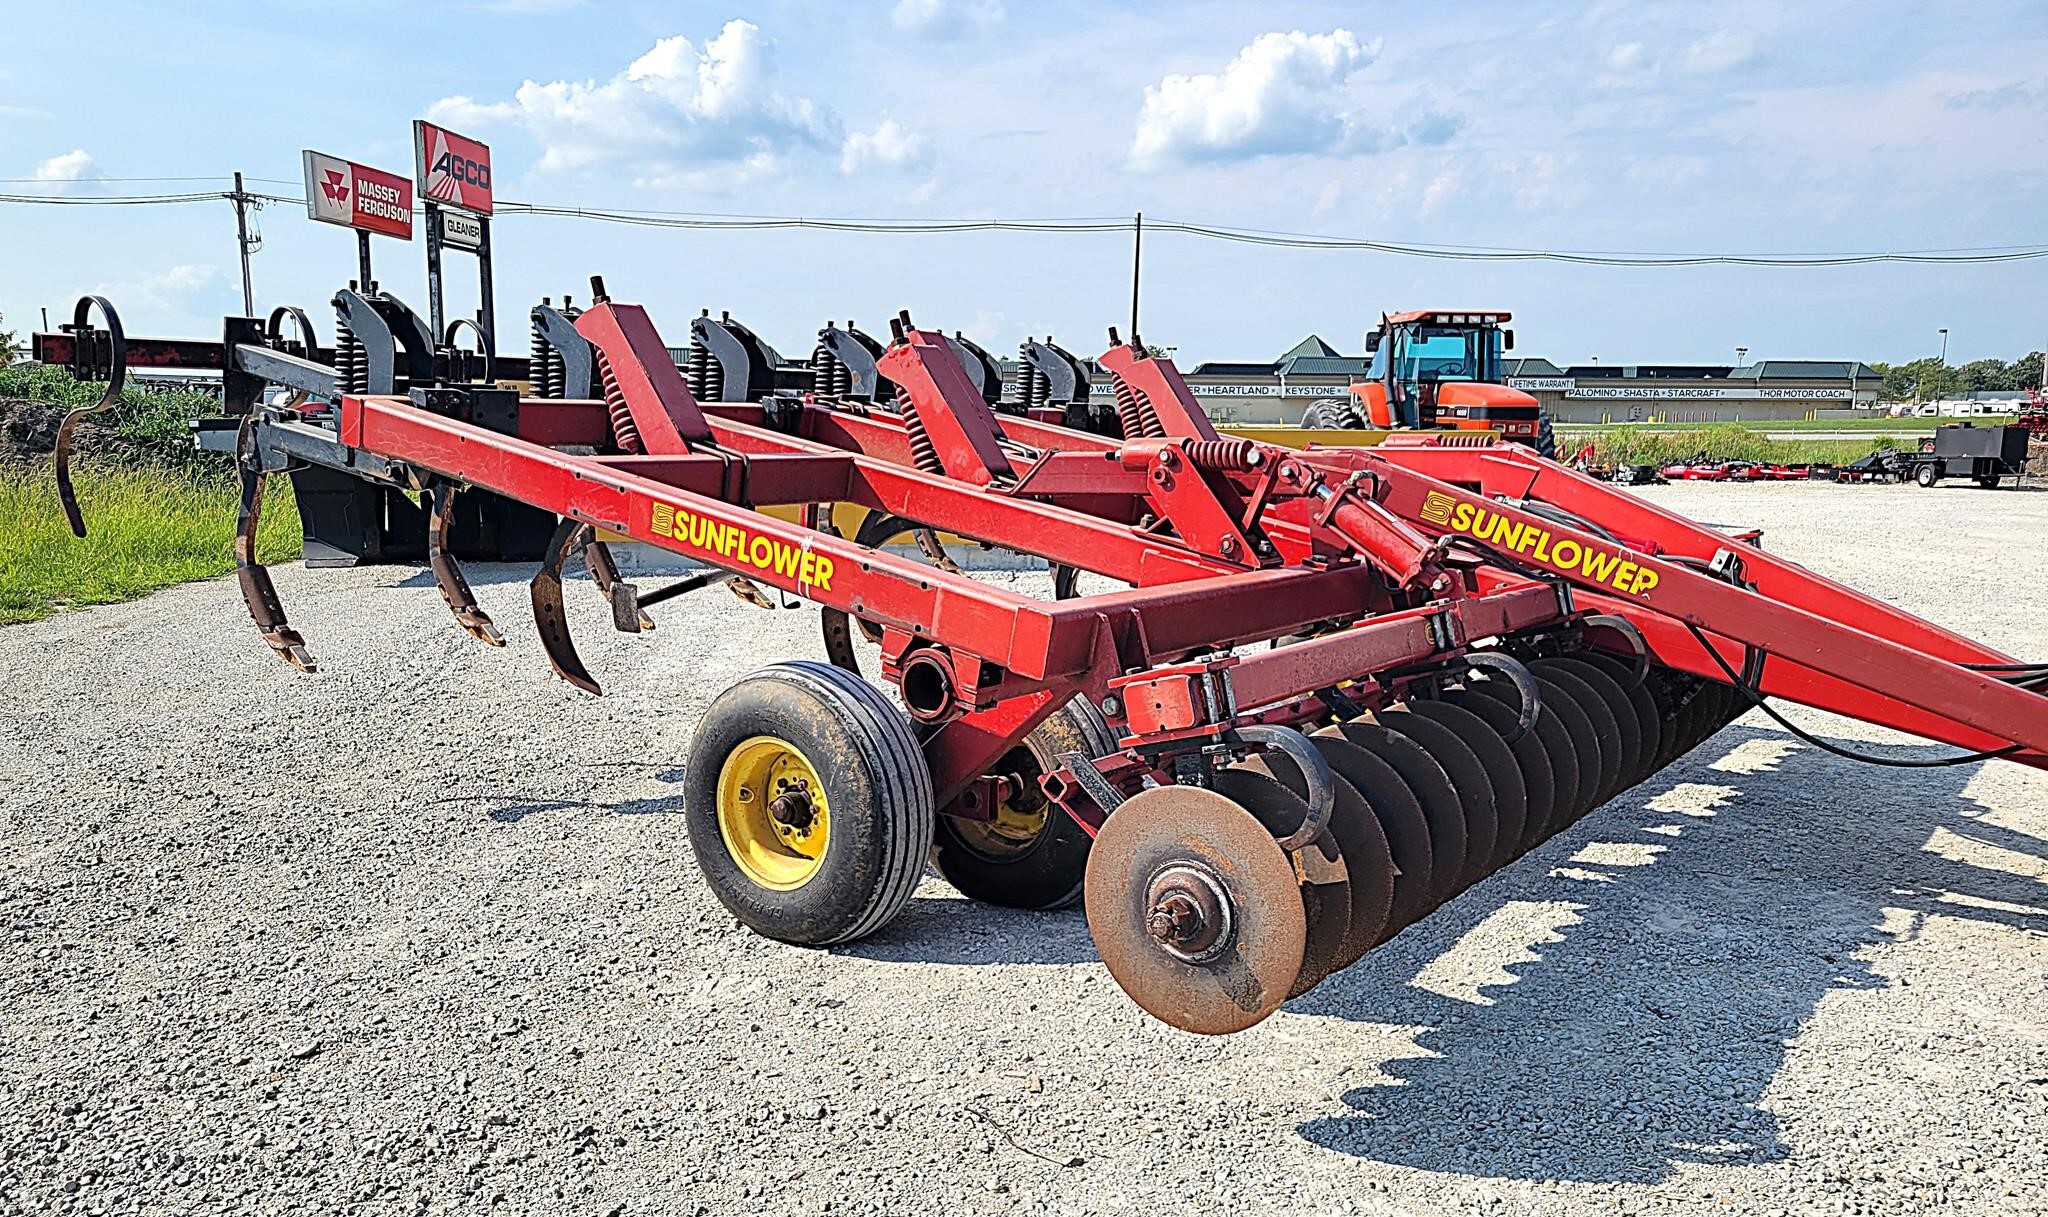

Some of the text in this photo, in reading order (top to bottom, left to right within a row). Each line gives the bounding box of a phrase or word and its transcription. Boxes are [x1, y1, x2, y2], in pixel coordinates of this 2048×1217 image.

[432, 152, 490, 189] AGCO
[357, 179, 401, 204] MASSEY
[358, 196, 411, 224] FERGUSON
[447, 219, 480, 238] GLEANER
[1207, 386, 1269, 395] HEARTLAND
[1285, 387, 1336, 395] KEYSTONE
[1509, 379, 1575, 389] LIFETIME WARRANTY
[1568, 389, 1720, 397] PALOMINO SHASTA STARCRAFT
[1760, 389, 1845, 398] THOR MOTOR COACH
[673, 509, 834, 592] SUNFLOWER
[1450, 502, 1659, 599] SUNFLOWER
